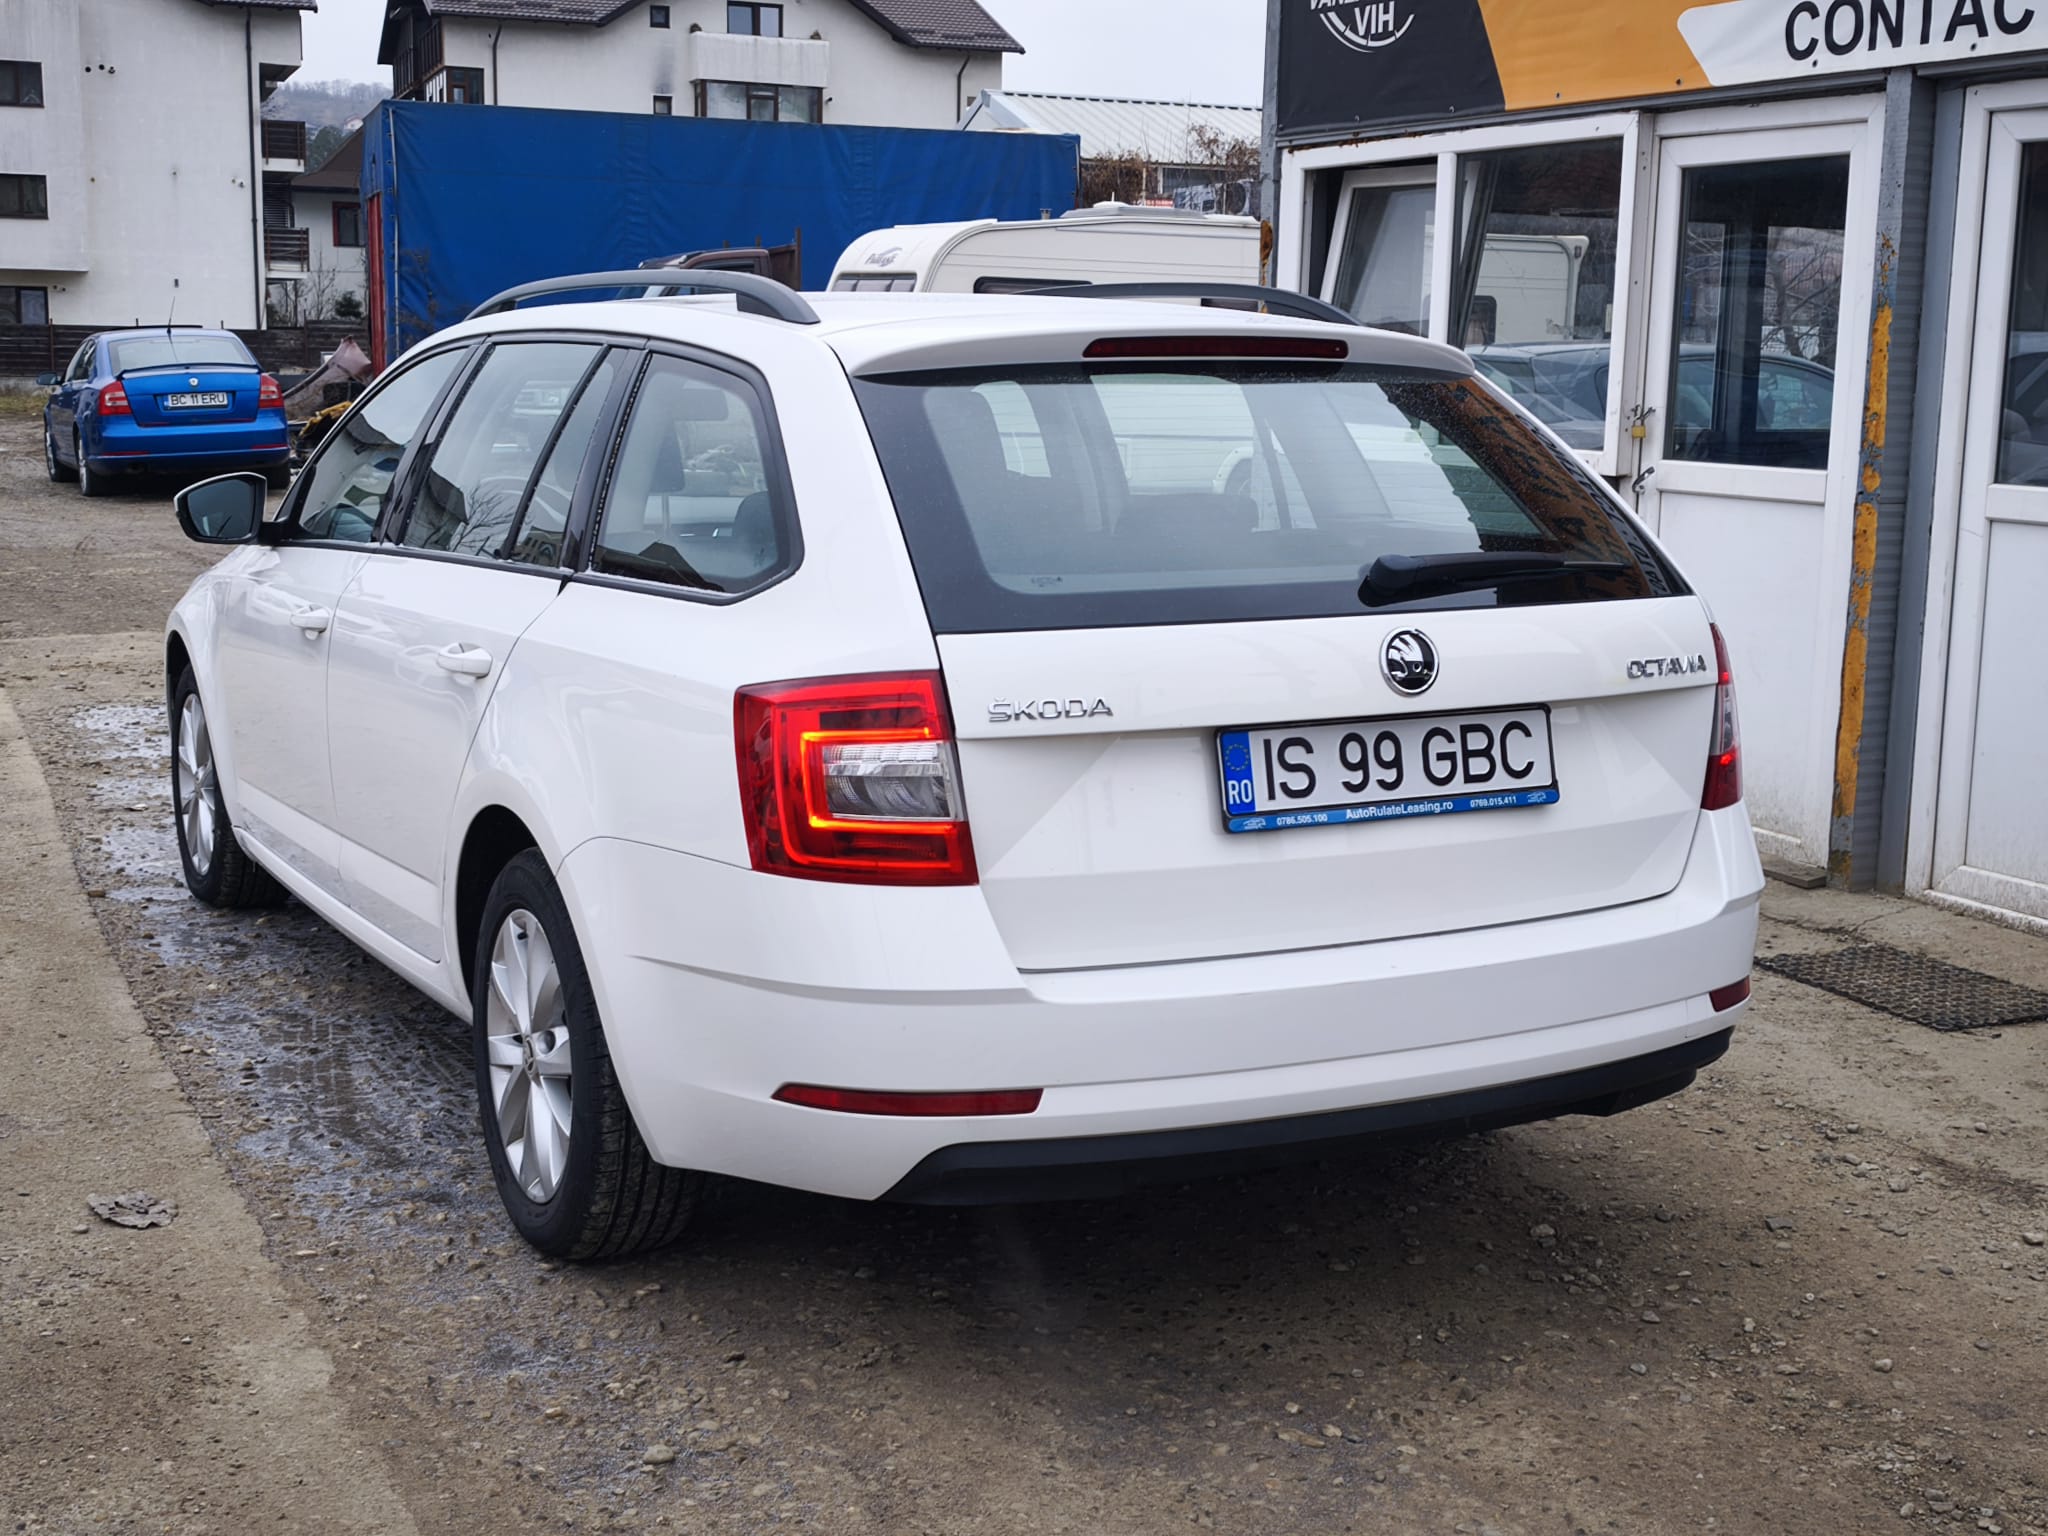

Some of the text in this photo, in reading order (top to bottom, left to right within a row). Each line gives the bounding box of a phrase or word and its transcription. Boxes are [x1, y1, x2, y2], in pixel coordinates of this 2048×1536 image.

[1354, 1, 1395, 36] VIH
[170, 393, 225, 406] BC 11 ERU
[1627, 653, 1707, 679] OCTAVIA
[1263, 720, 1535, 801] IS 99 GBC
[1227, 779, 1253, 804] RO
[1346, 801, 1454, 819] AutoRulateLeasing.ro
